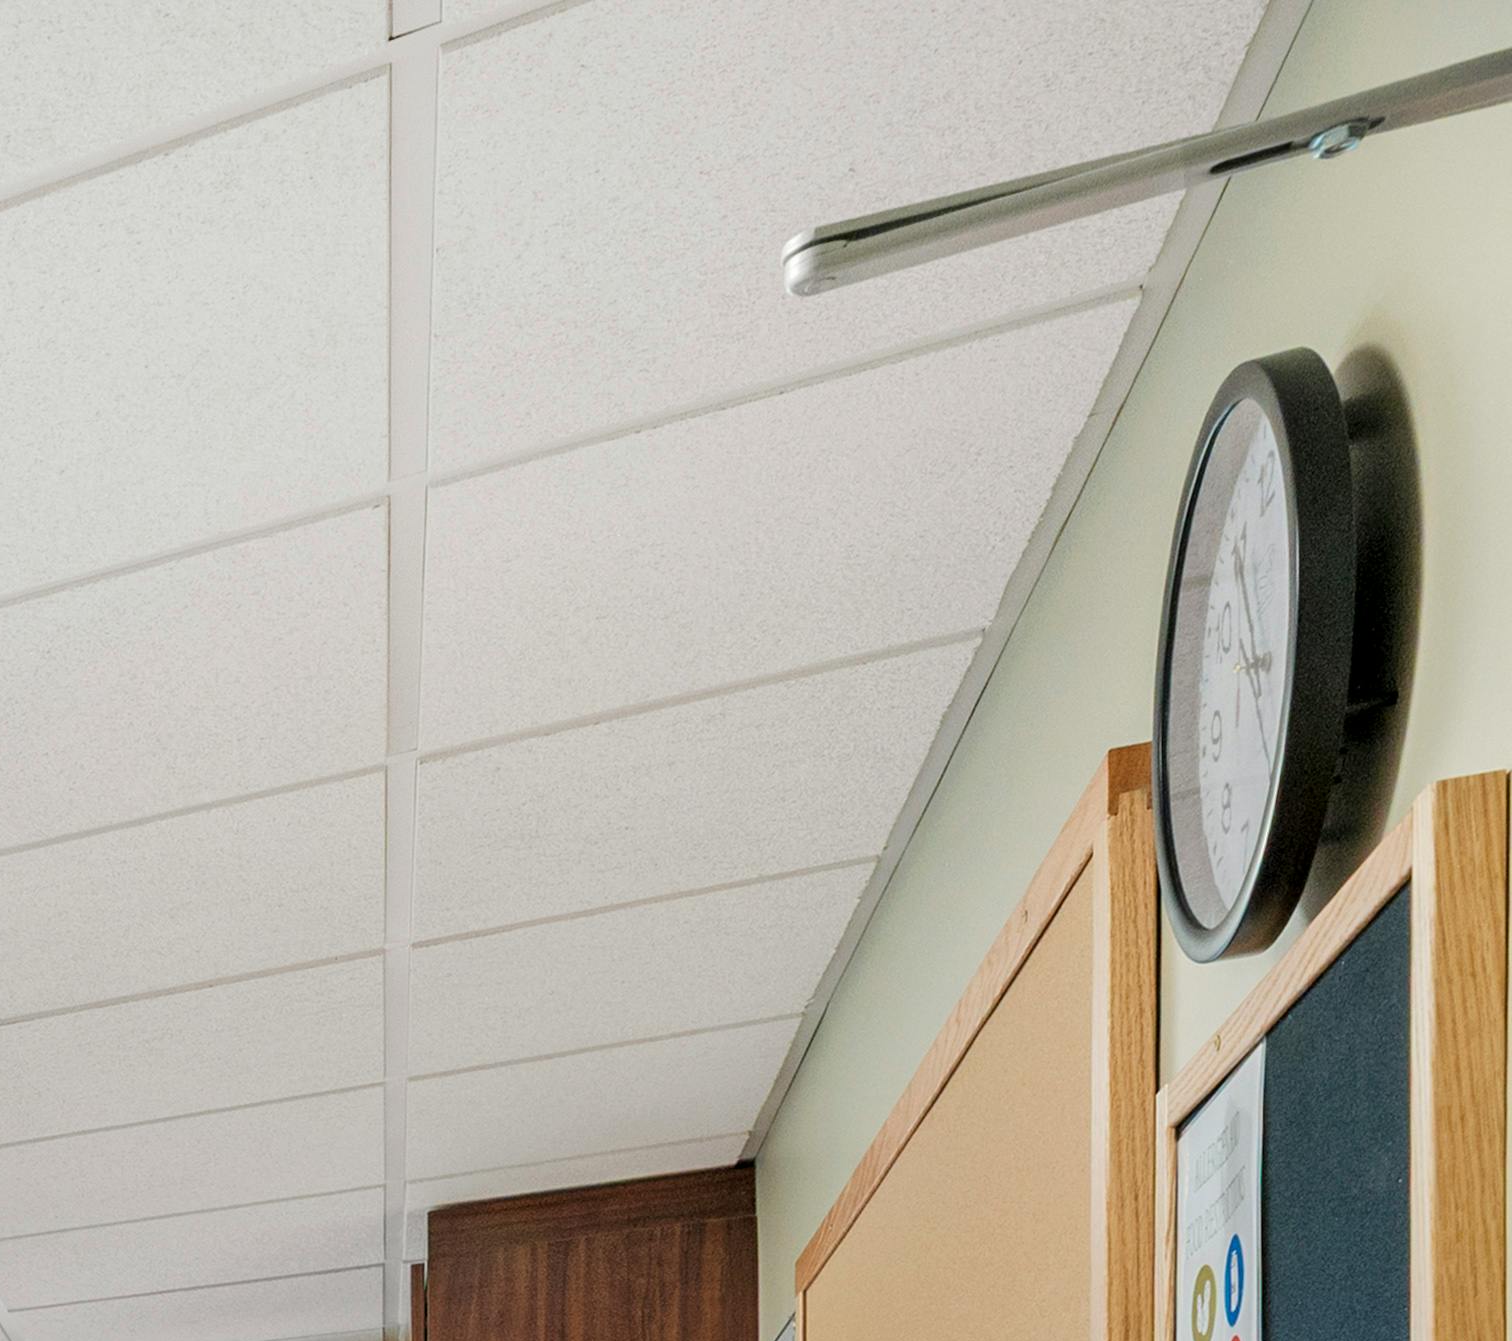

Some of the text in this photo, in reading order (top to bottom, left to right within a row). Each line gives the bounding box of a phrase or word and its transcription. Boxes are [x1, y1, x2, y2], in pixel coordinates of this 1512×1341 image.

[1256, 449, 1276, 518] 12
[1216, 600, 1233, 664] 10
[1210, 709, 1223, 763] 9
[1220, 782, 1233, 834] 8
